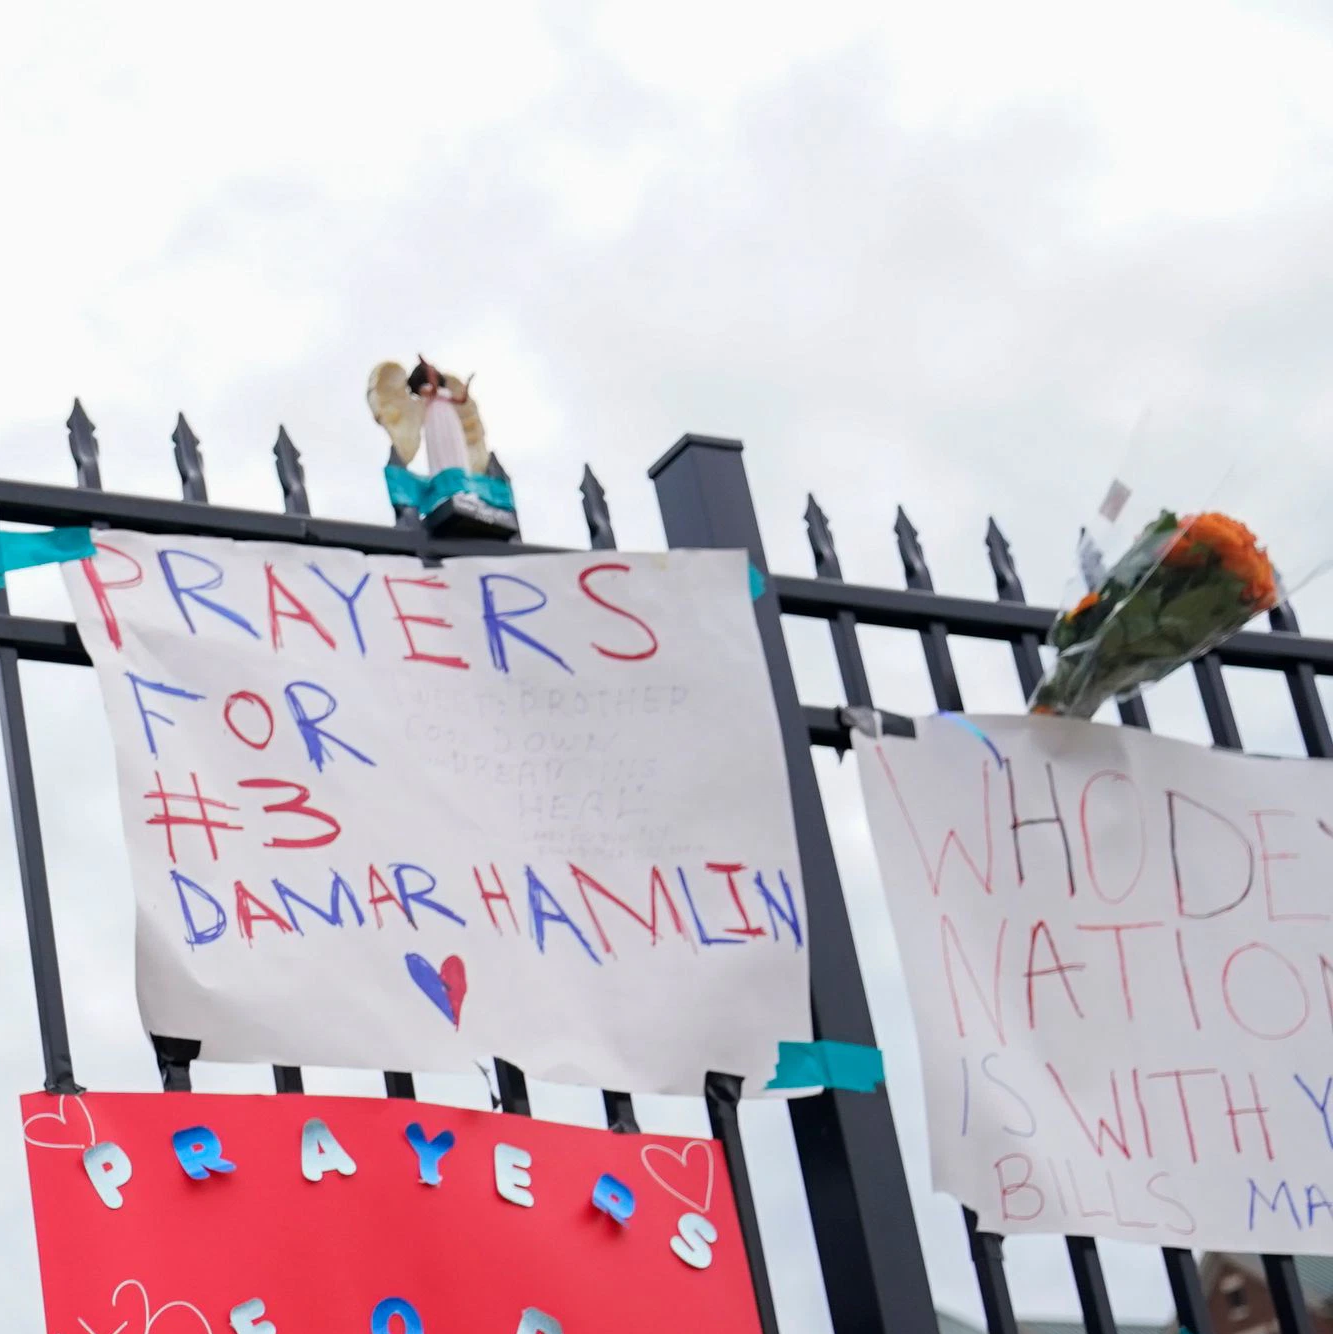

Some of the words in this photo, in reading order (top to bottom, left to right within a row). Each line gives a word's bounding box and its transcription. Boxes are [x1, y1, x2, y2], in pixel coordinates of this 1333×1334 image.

[79, 541, 660, 675] PRAYERS
[125, 671, 377, 773] FOR
[144, 769, 342, 864] #3
[1165, 789, 1333, 922] DE
[168, 862, 467, 953] DAMAR
[472, 862, 806, 965] HAMLIN
[959, 1052, 1037, 1138] IS
[1045, 1060, 1275, 1165] WITH
[82, 1117, 719, 1271] PRAYERS
[993, 1152, 1197, 1236] BILLS
